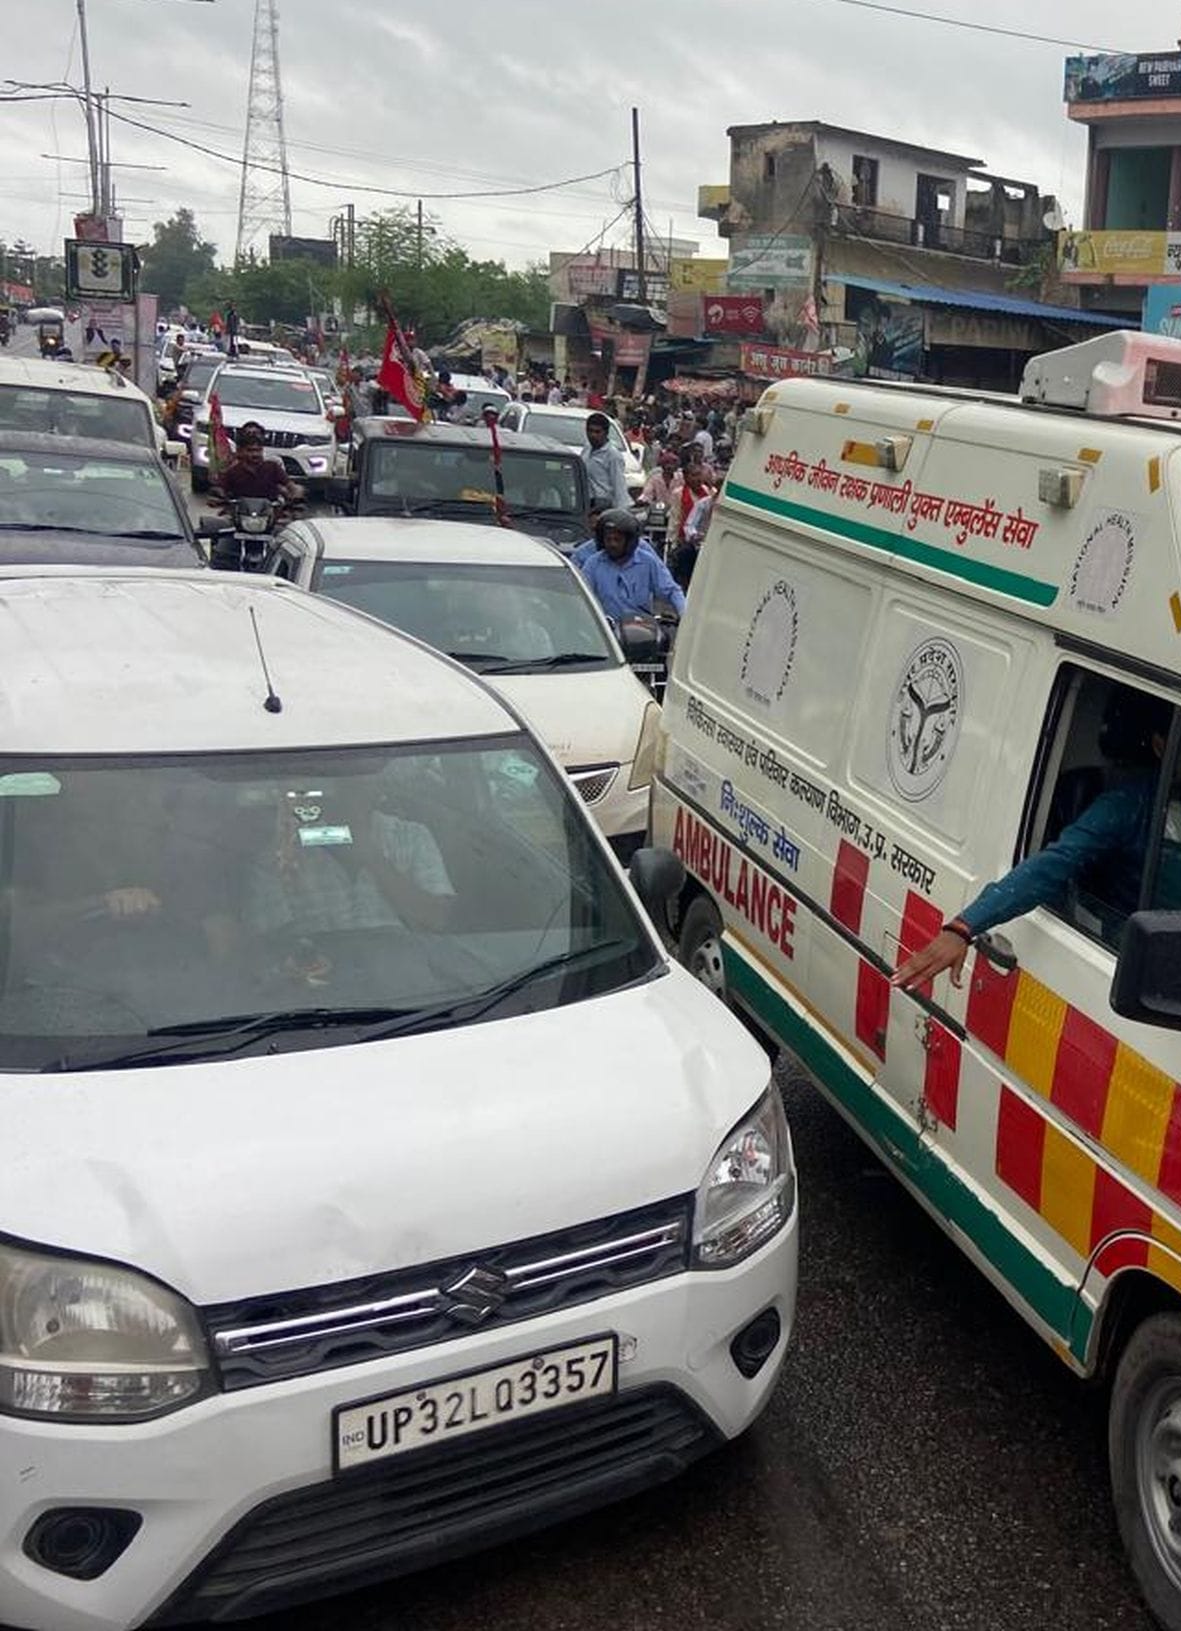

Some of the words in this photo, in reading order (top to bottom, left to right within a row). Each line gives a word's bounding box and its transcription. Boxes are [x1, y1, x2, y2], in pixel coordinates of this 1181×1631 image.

[765, 451, 808, 488] आधुनिक
[808, 459, 841, 495] जीवन
[840, 474, 871, 501] रक्षक
[867, 479, 911, 514] प्रणाली
[911, 492, 945, 531] युक्त
[1002, 507, 1039, 549] सेवा
[687, 696, 717, 740] चिकित्सा
[760, 749, 789, 789] परिवार
[789, 772, 827, 814] कल्याण
[890, 843, 937, 895] सरकार
[673, 805, 798, 961] AMBULANCE
[772, 825, 801, 872] सेवा
[342, 1431, 365, 1446] IND
[366, 1350, 610, 1450] UP32LQ3357
